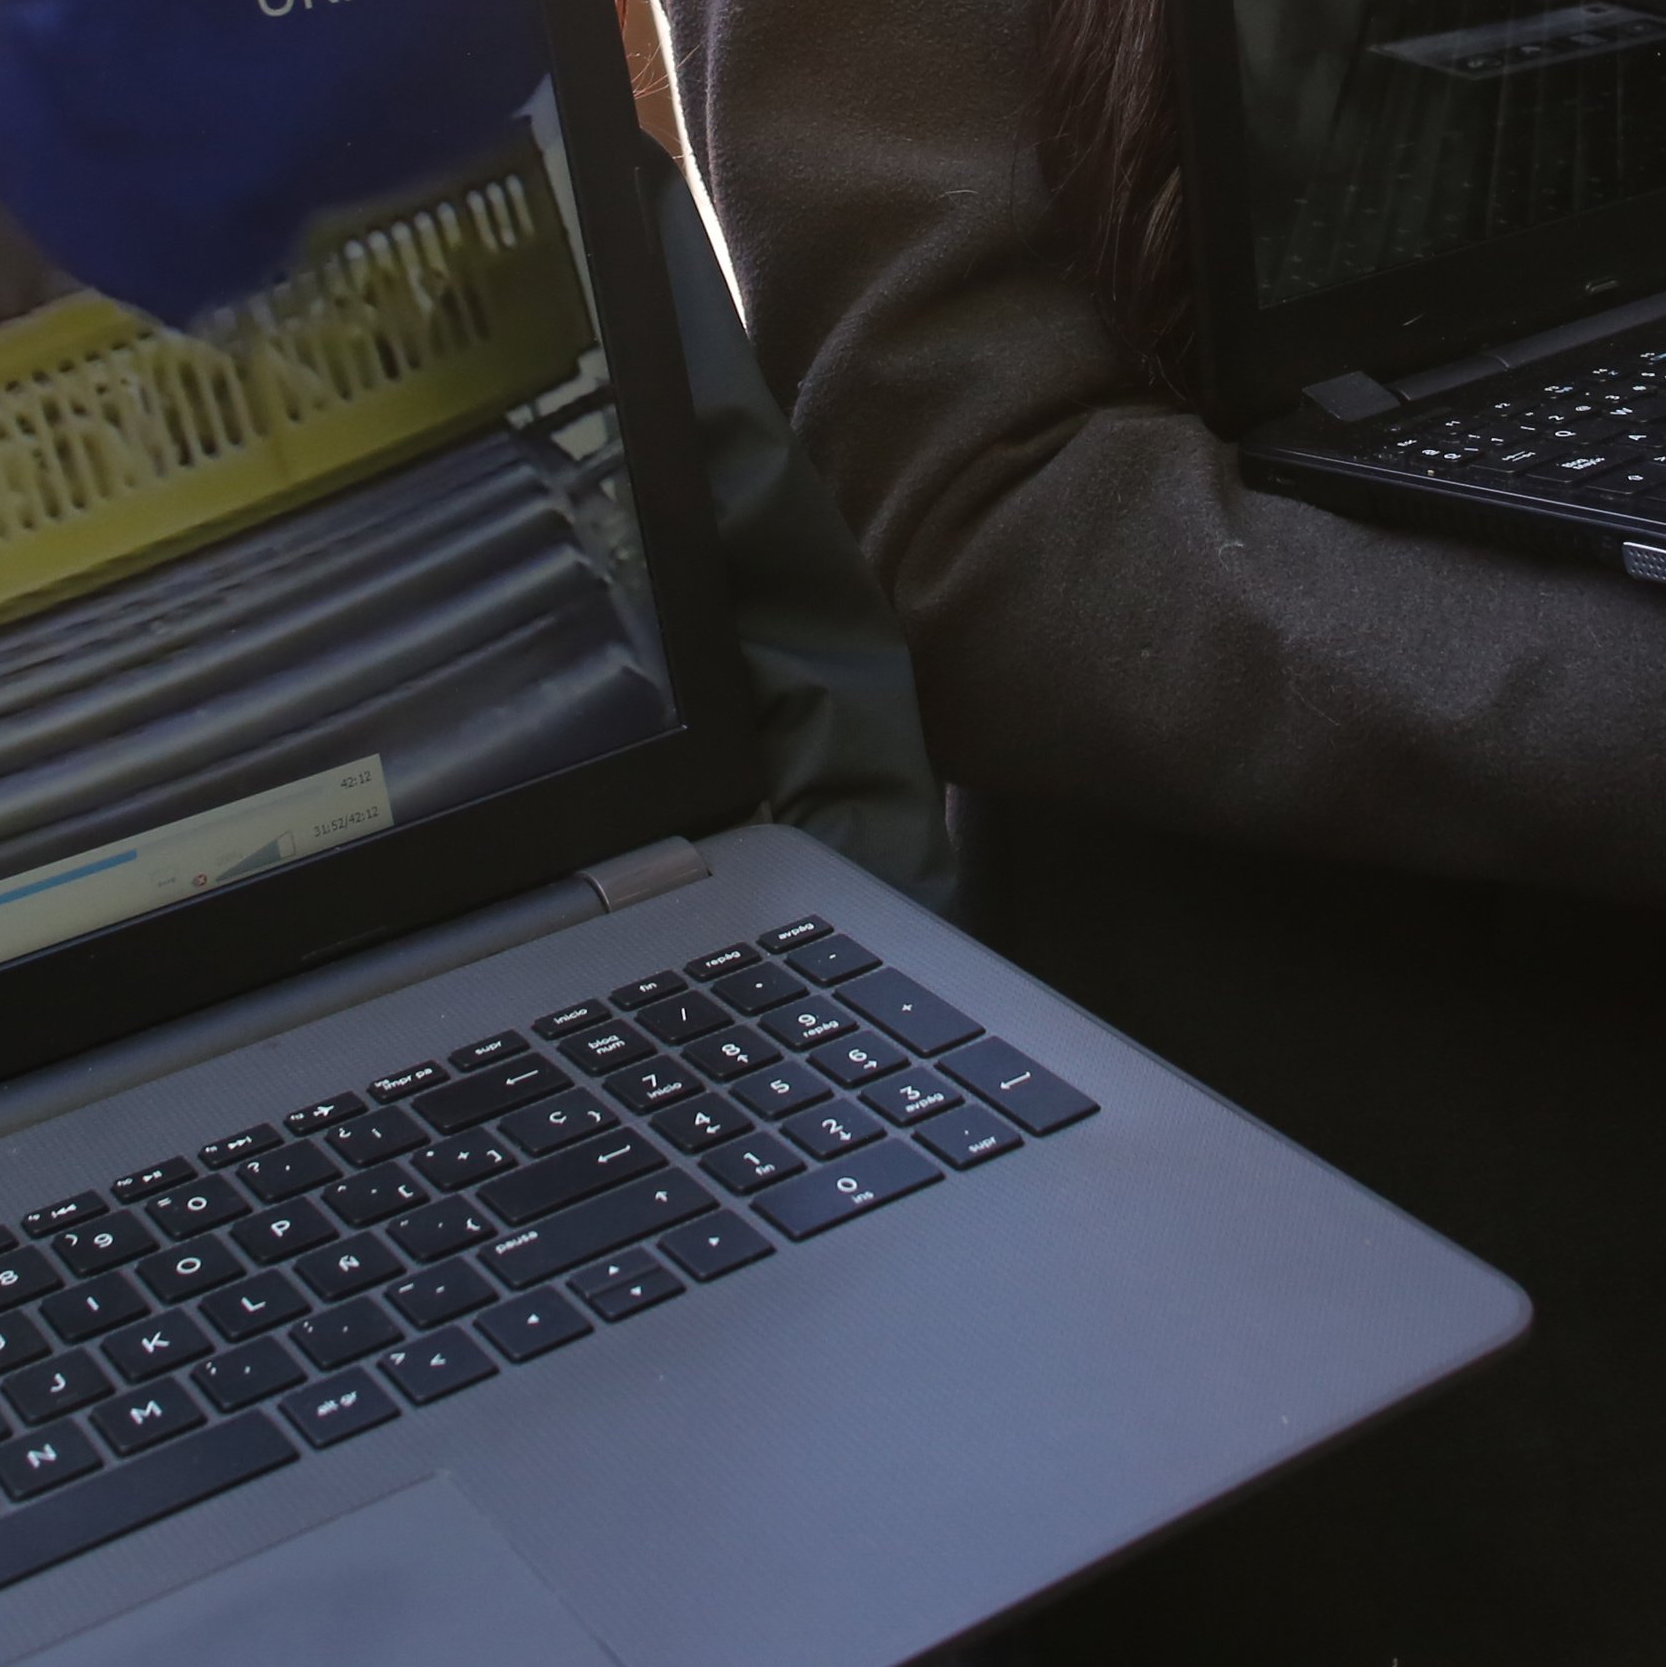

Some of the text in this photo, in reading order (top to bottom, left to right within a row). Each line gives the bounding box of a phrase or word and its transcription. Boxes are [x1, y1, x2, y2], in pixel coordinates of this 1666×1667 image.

[340, 770, 372, 789] 42:12
[314, 806, 380, 837] 31:52/42:12
[639, 982, 658, 993] fin
[554, 1009, 587, 1024] inicio
[797, 1014, 817, 1027] 9
[475, 1041, 501, 1055] supr
[597, 1039, 626, 1055] num
[721, 1043, 741, 1057] 8
[848, 1048, 868, 1062] 6
[642, 1074, 656, 1087] 7
[771, 1080, 789, 1093] 5
[647, 1083, 682, 1098] inicio
[900, 1086, 920, 1100] 3
[694, 1112, 711, 1126] 4
[822, 1119, 842, 1133] 2
[969, 1137, 996, 1152] supr
[743, 1152, 761, 1165] 1
[755, 1164, 776, 1176] fin
[851, 1191, 874, 1204] ins
[271, 1220, 290, 1236] P
[94, 1234, 113, 1247] 9
[177, 1258, 201, 1274] O
[87, 1297, 99, 1310] I
[242, 1298, 265, 1311] L
[142, 1332, 169, 1352] K
[51, 1373, 65, 1392] J
[130, 1401, 162, 1424] M
[27, 1444, 56, 1467] N
